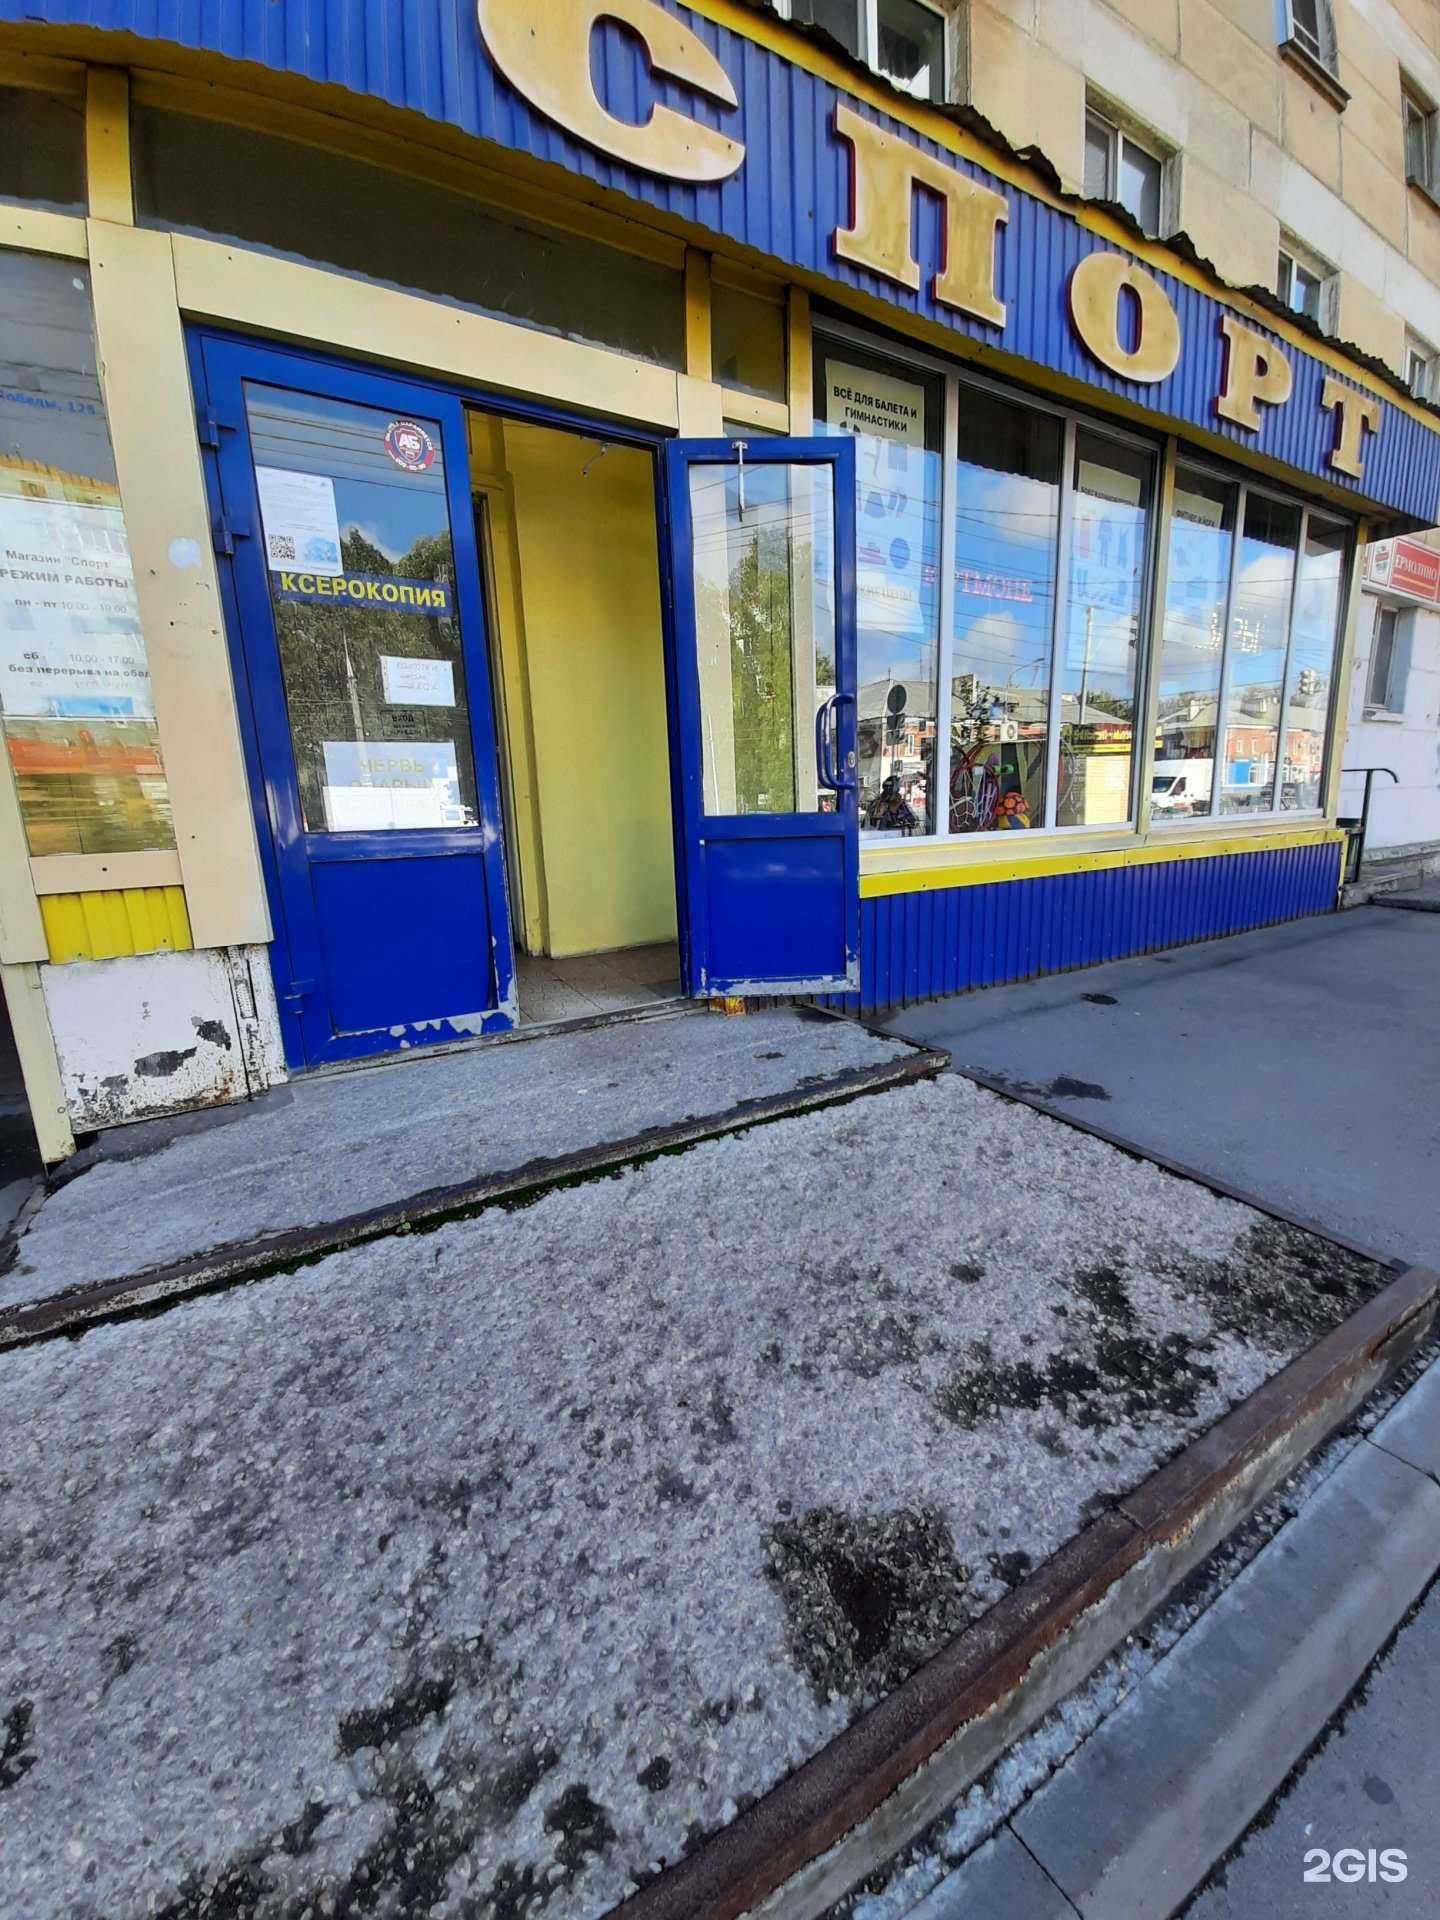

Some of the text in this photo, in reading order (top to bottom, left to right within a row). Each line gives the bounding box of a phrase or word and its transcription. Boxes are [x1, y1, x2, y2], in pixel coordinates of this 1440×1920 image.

[476, 0, 1380, 479] СПОРТ
[833, 386, 918, 419] ВСЁ ДЛЯ БАЛЕТА И
[844, 407, 908, 433] ГИМНАСТИКИ
[399, 433, 421, 450] АБ
[5, 549, 61, 565] Магазин
[0, 568, 129, 589] РЕЖИМ РАБОТЫ
[280, 572, 447, 608] КСЕРОКОПИЯ
